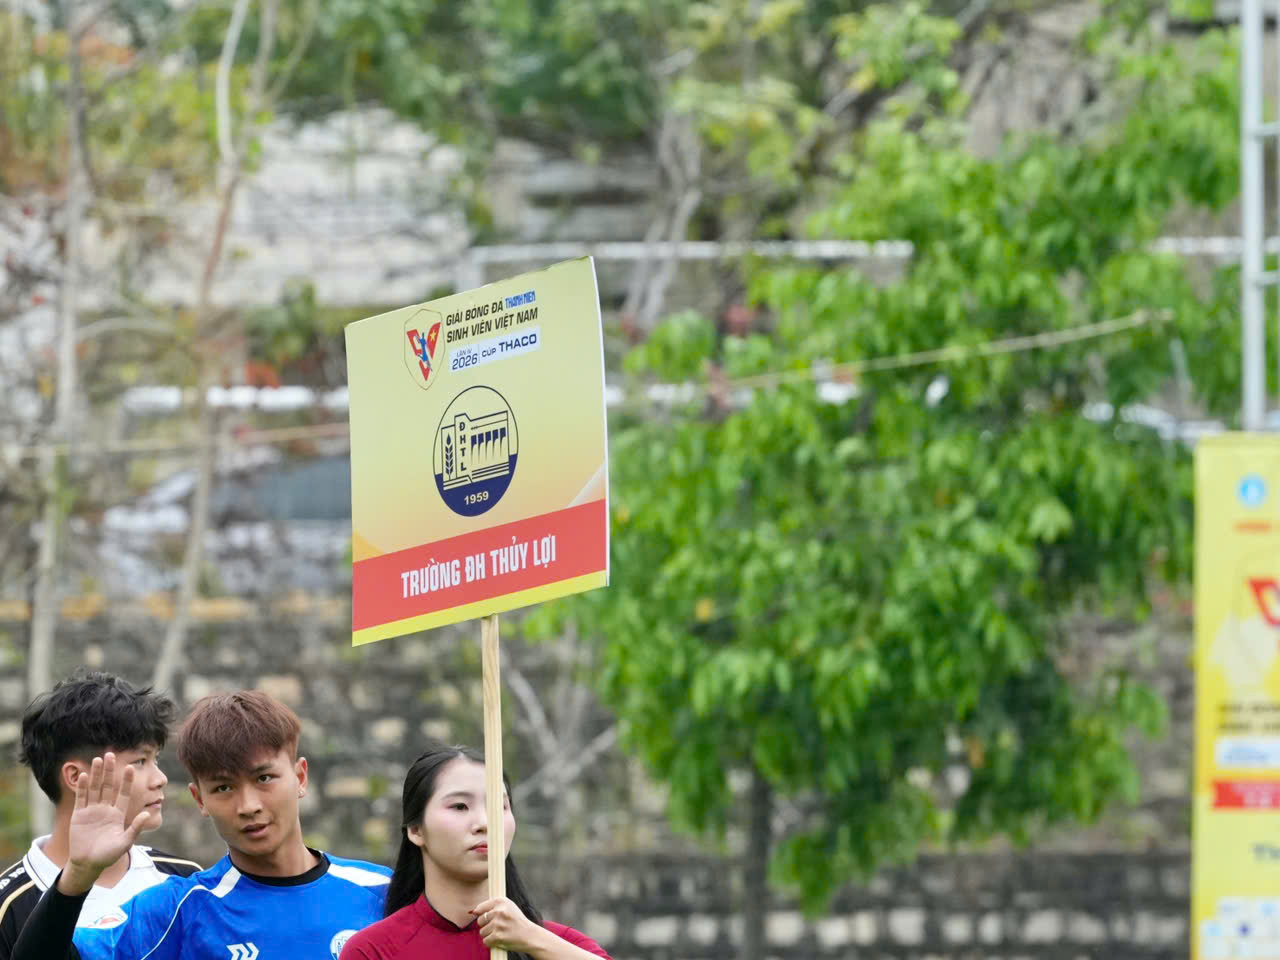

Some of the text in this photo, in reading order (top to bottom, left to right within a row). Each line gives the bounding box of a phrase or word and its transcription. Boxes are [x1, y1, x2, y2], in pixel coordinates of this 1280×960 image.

[446, 326, 468, 343] SINH
[494, 313, 514, 330] VIỆT
[516, 307, 538, 324] NAM
[498, 333, 538, 352] THACO
[452, 353, 478, 370] 2026
[464, 491, 489, 505] 1959
[401, 534, 556, 598] TRƯỜNG ĐH THỦY LỢI
